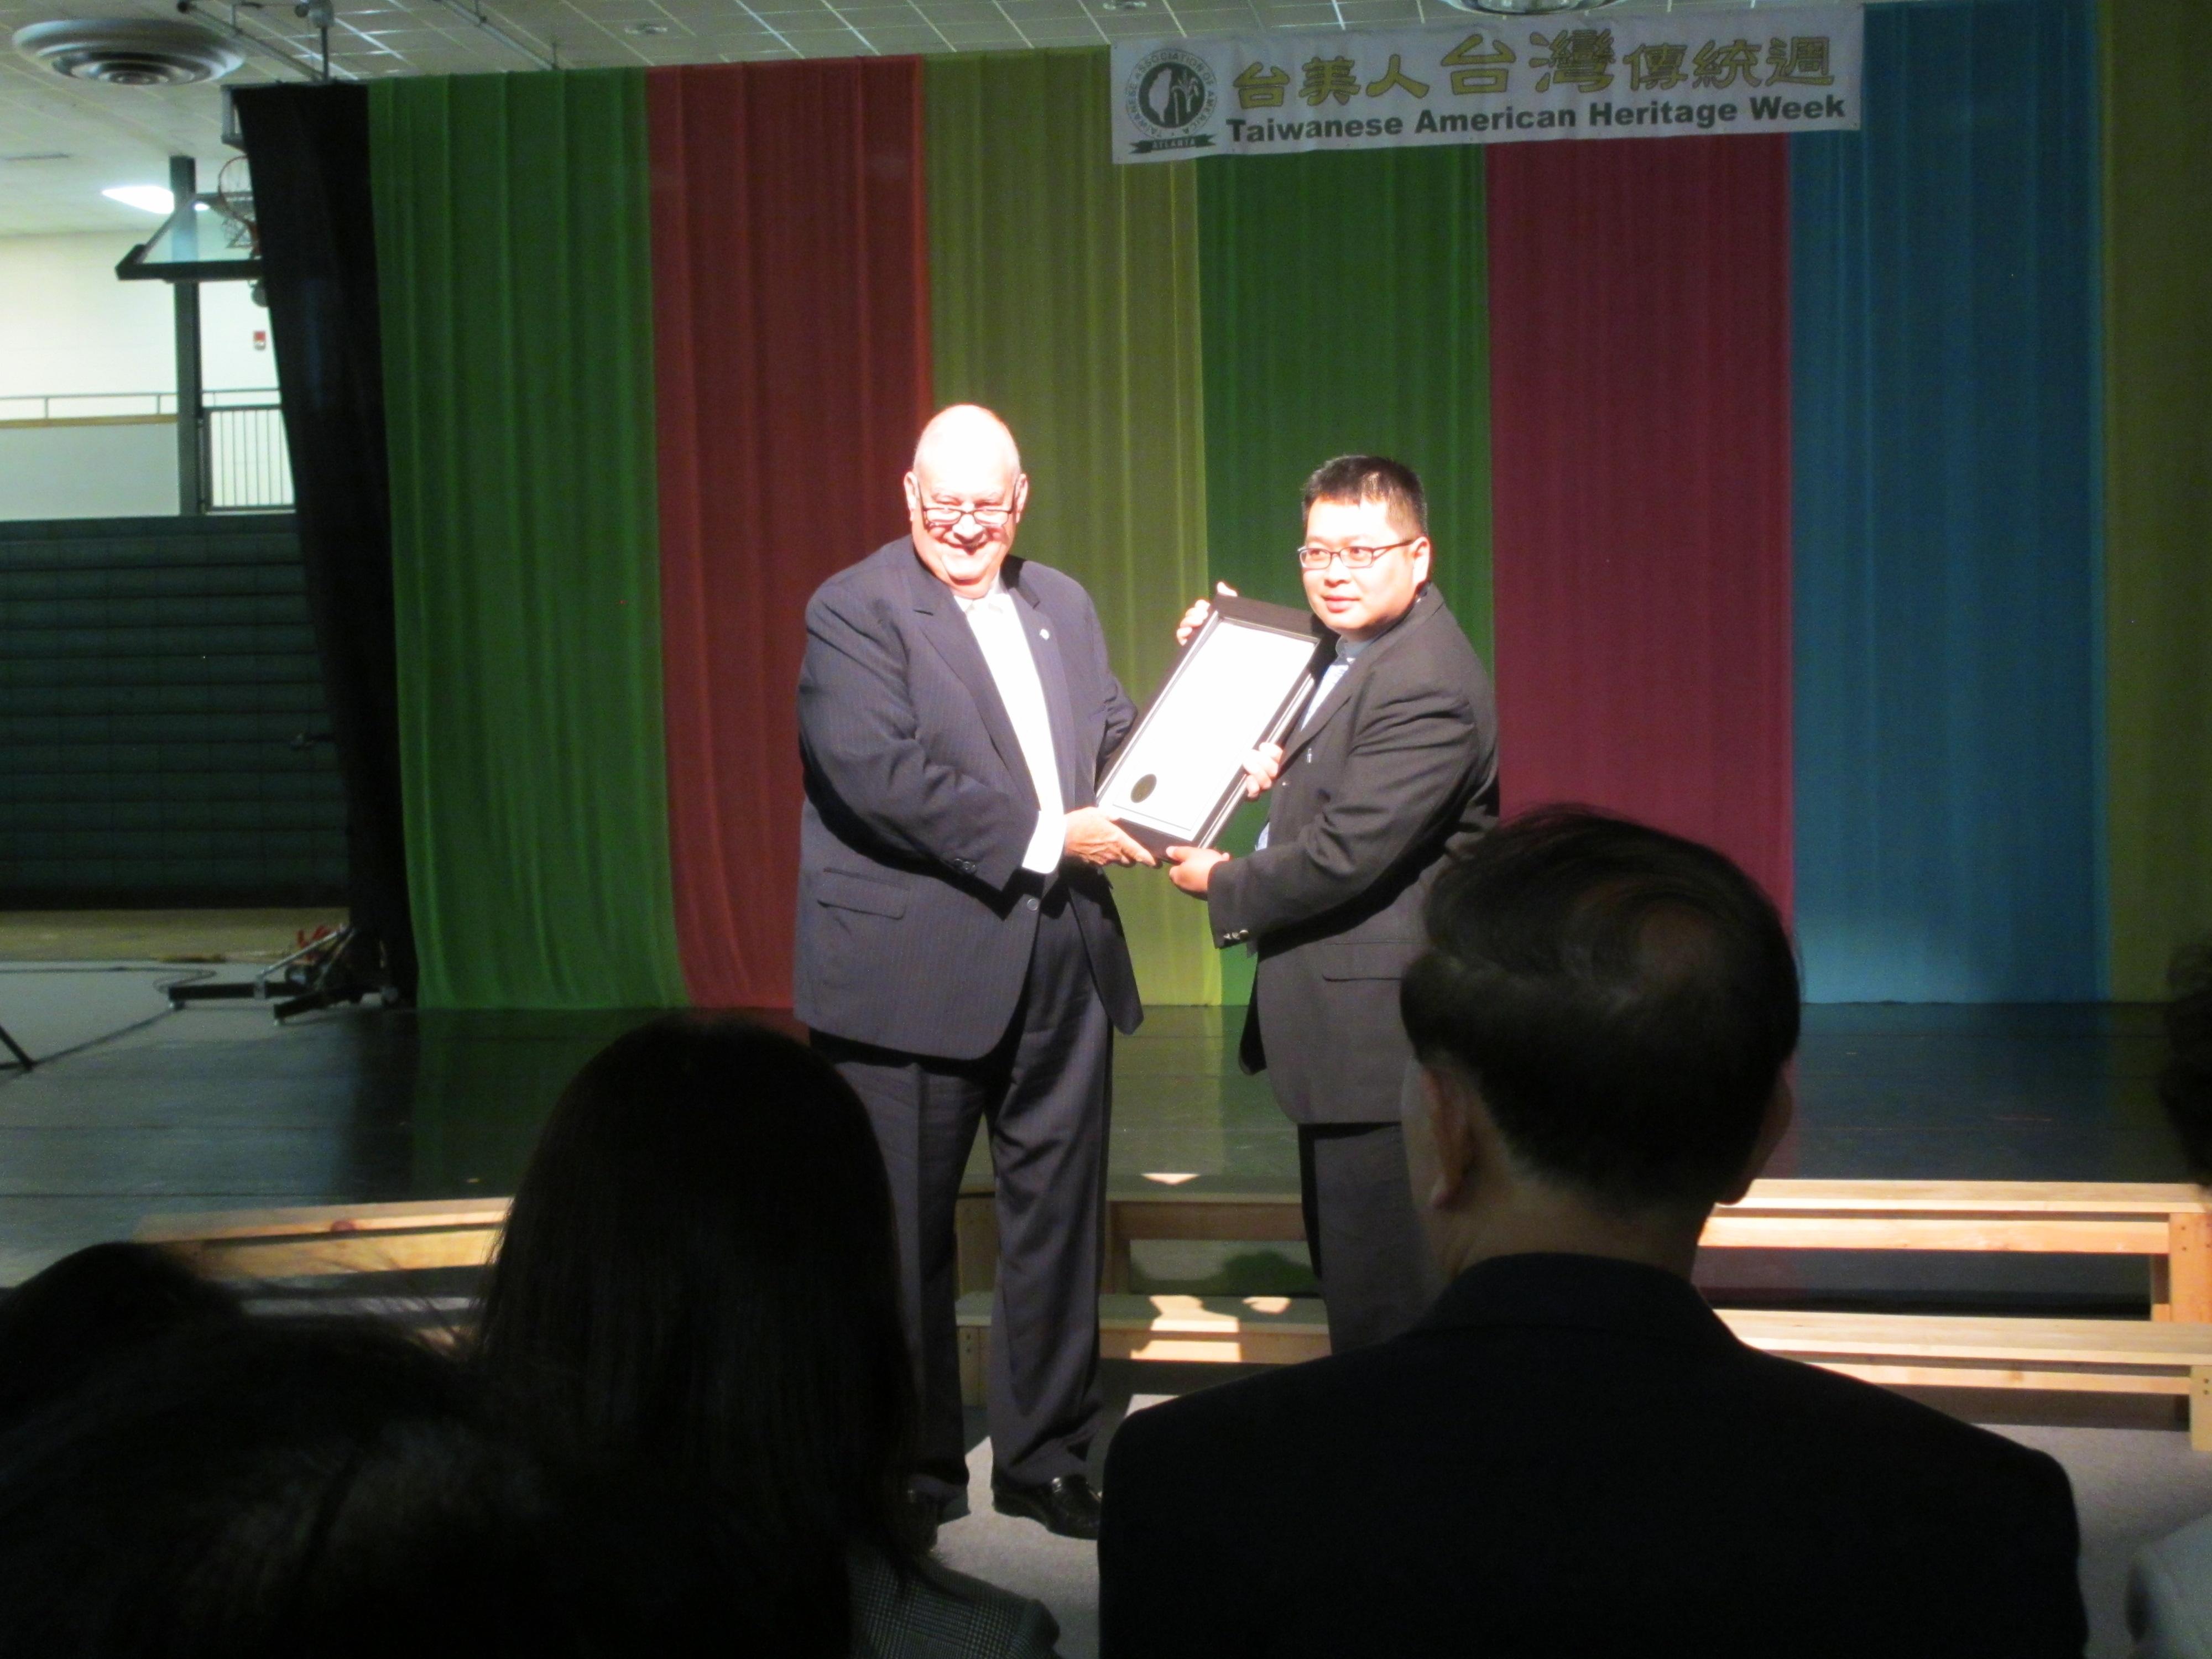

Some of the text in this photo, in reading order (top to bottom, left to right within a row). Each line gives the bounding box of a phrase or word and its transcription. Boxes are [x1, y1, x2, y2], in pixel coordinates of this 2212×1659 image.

[1233, 29, 1834, 109] 台美人台灣傳統週
[1226, 95, 1845, 143] Taiwanese American Heritage Week
[1152, 138, 1196, 149] ATLANTA
